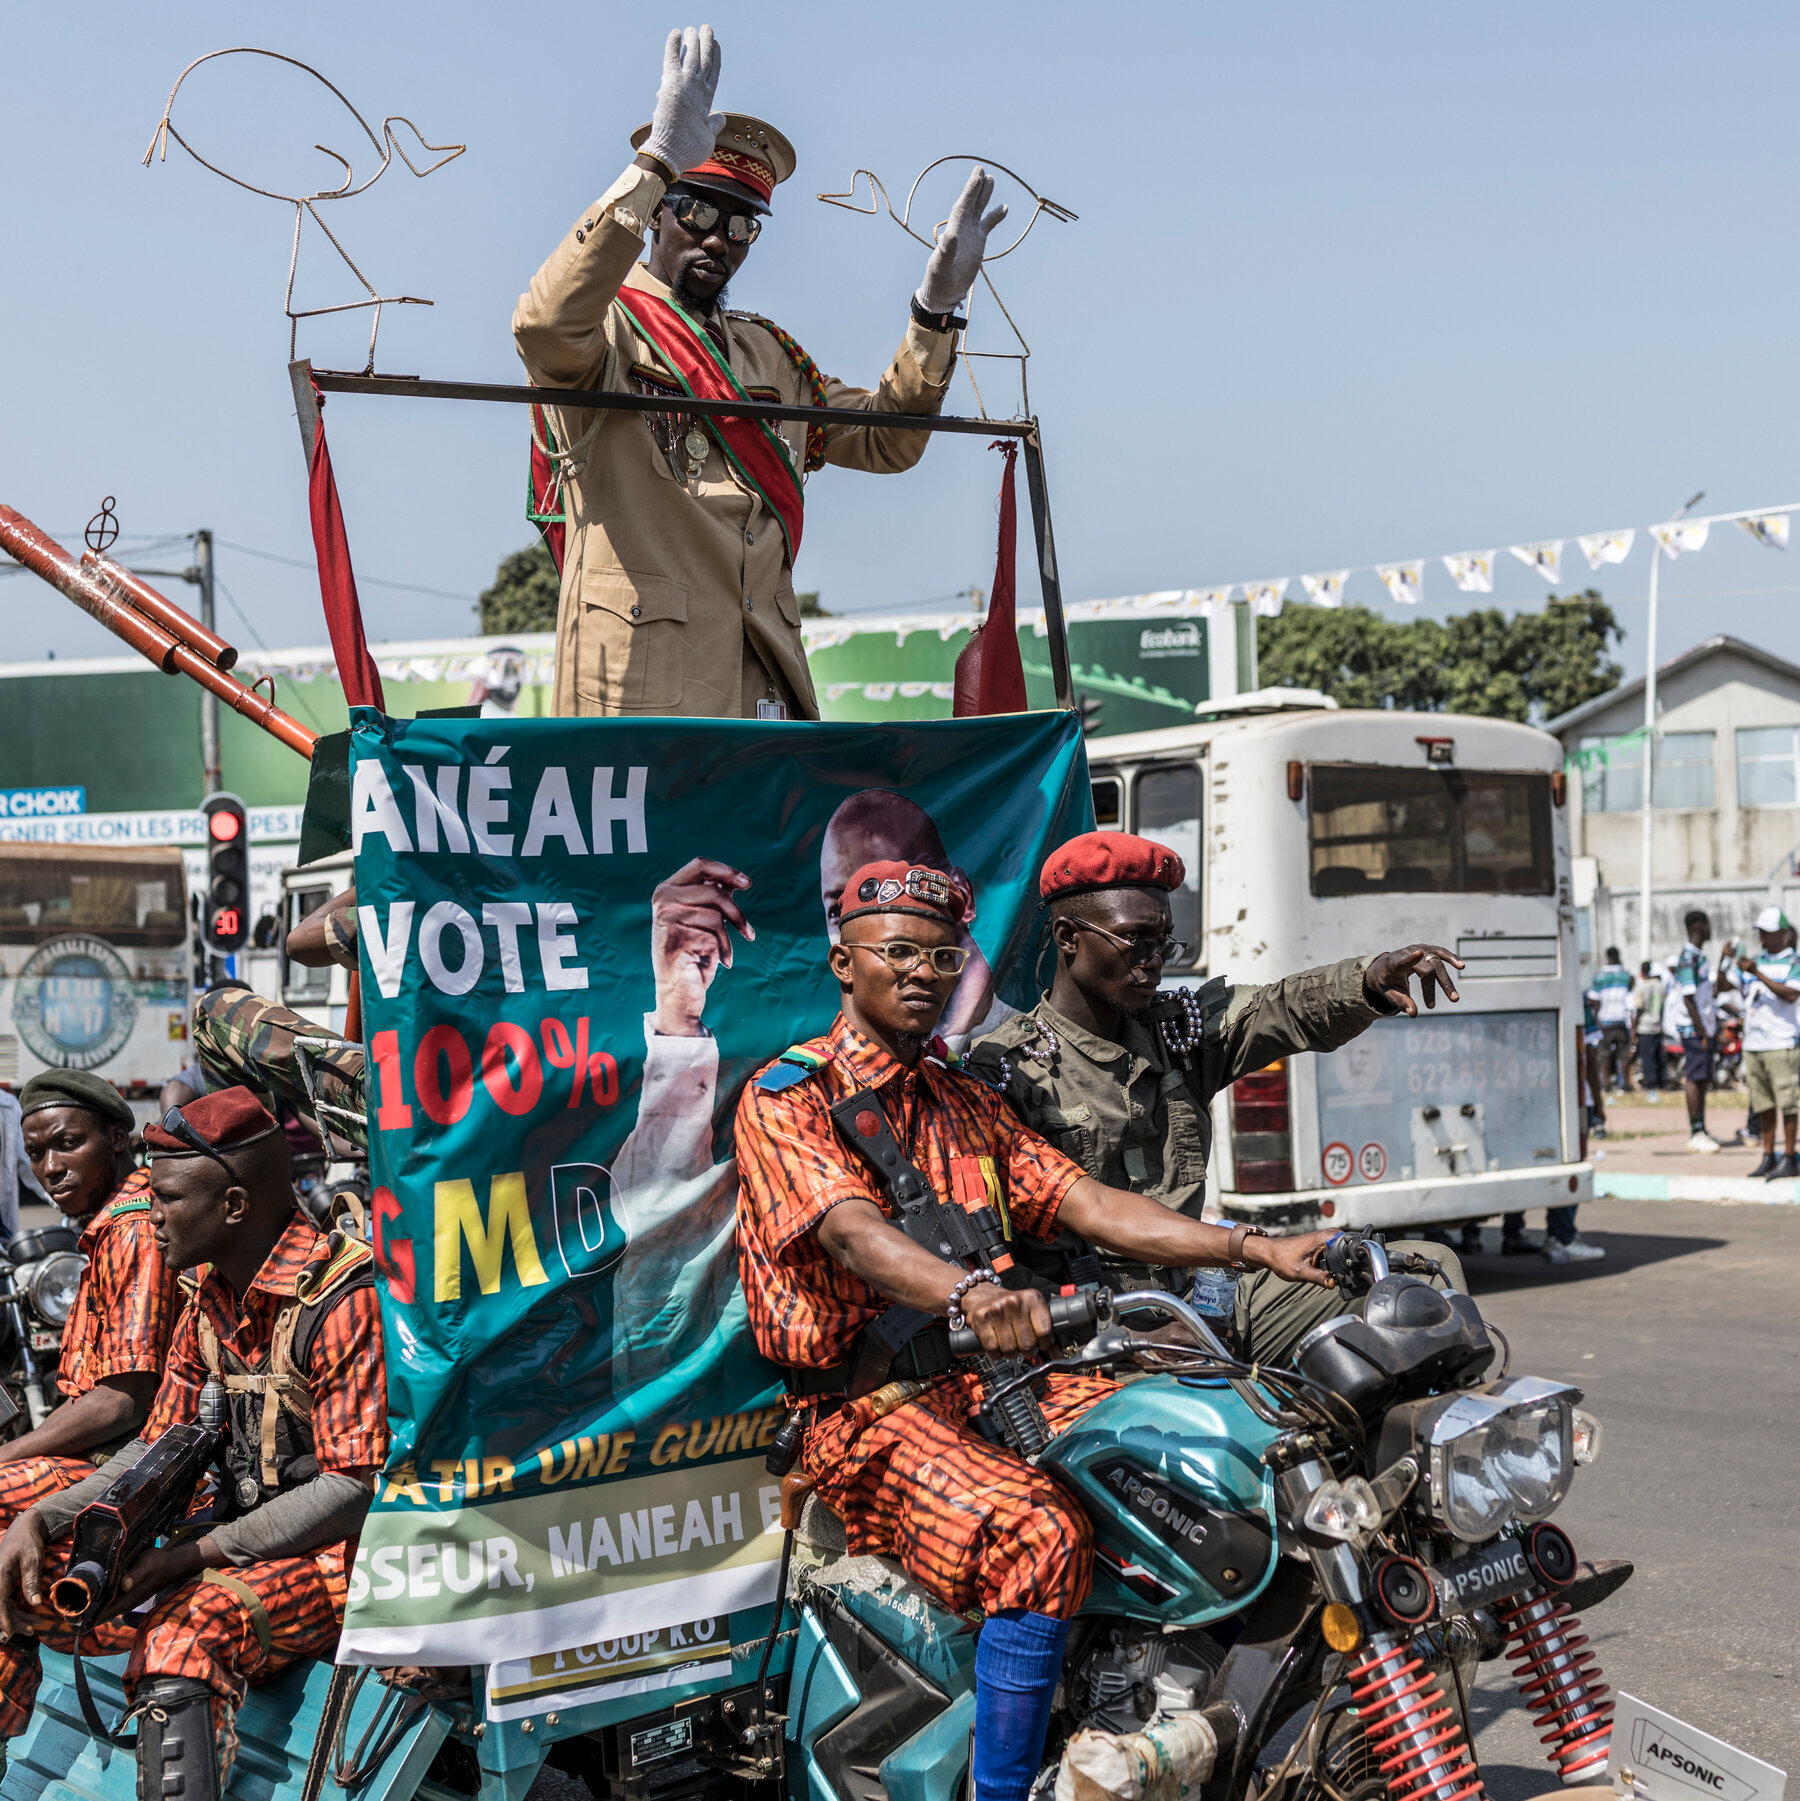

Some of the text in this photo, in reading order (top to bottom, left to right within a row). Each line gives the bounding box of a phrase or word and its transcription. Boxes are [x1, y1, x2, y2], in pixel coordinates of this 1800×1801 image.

[10, 790, 80, 816] CHOIX
[352, 746, 648, 856] ANÉAH
[64, 817, 131, 843] SELON
[137, 818, 172, 838] LES
[358, 901, 589, 999] VOTE
[371, 1016, 619, 1131] 100%
[1407, 1060, 1453, 1093] 622
[1329, 1153, 1347, 1171] 75
[1365, 1152, 1381, 1172] 90
[371, 1162, 631, 1303] GMD
[536, 1431, 636, 1485] UNE
[1106, 1467, 1208, 1545] APSONIC
[548, 1492, 744, 1579] MANEAH
[1444, 1553, 1527, 1602] APSONIC
[575, 1629, 660, 1664] COUP
[1646, 1742, 1725, 1790] APSONIC
